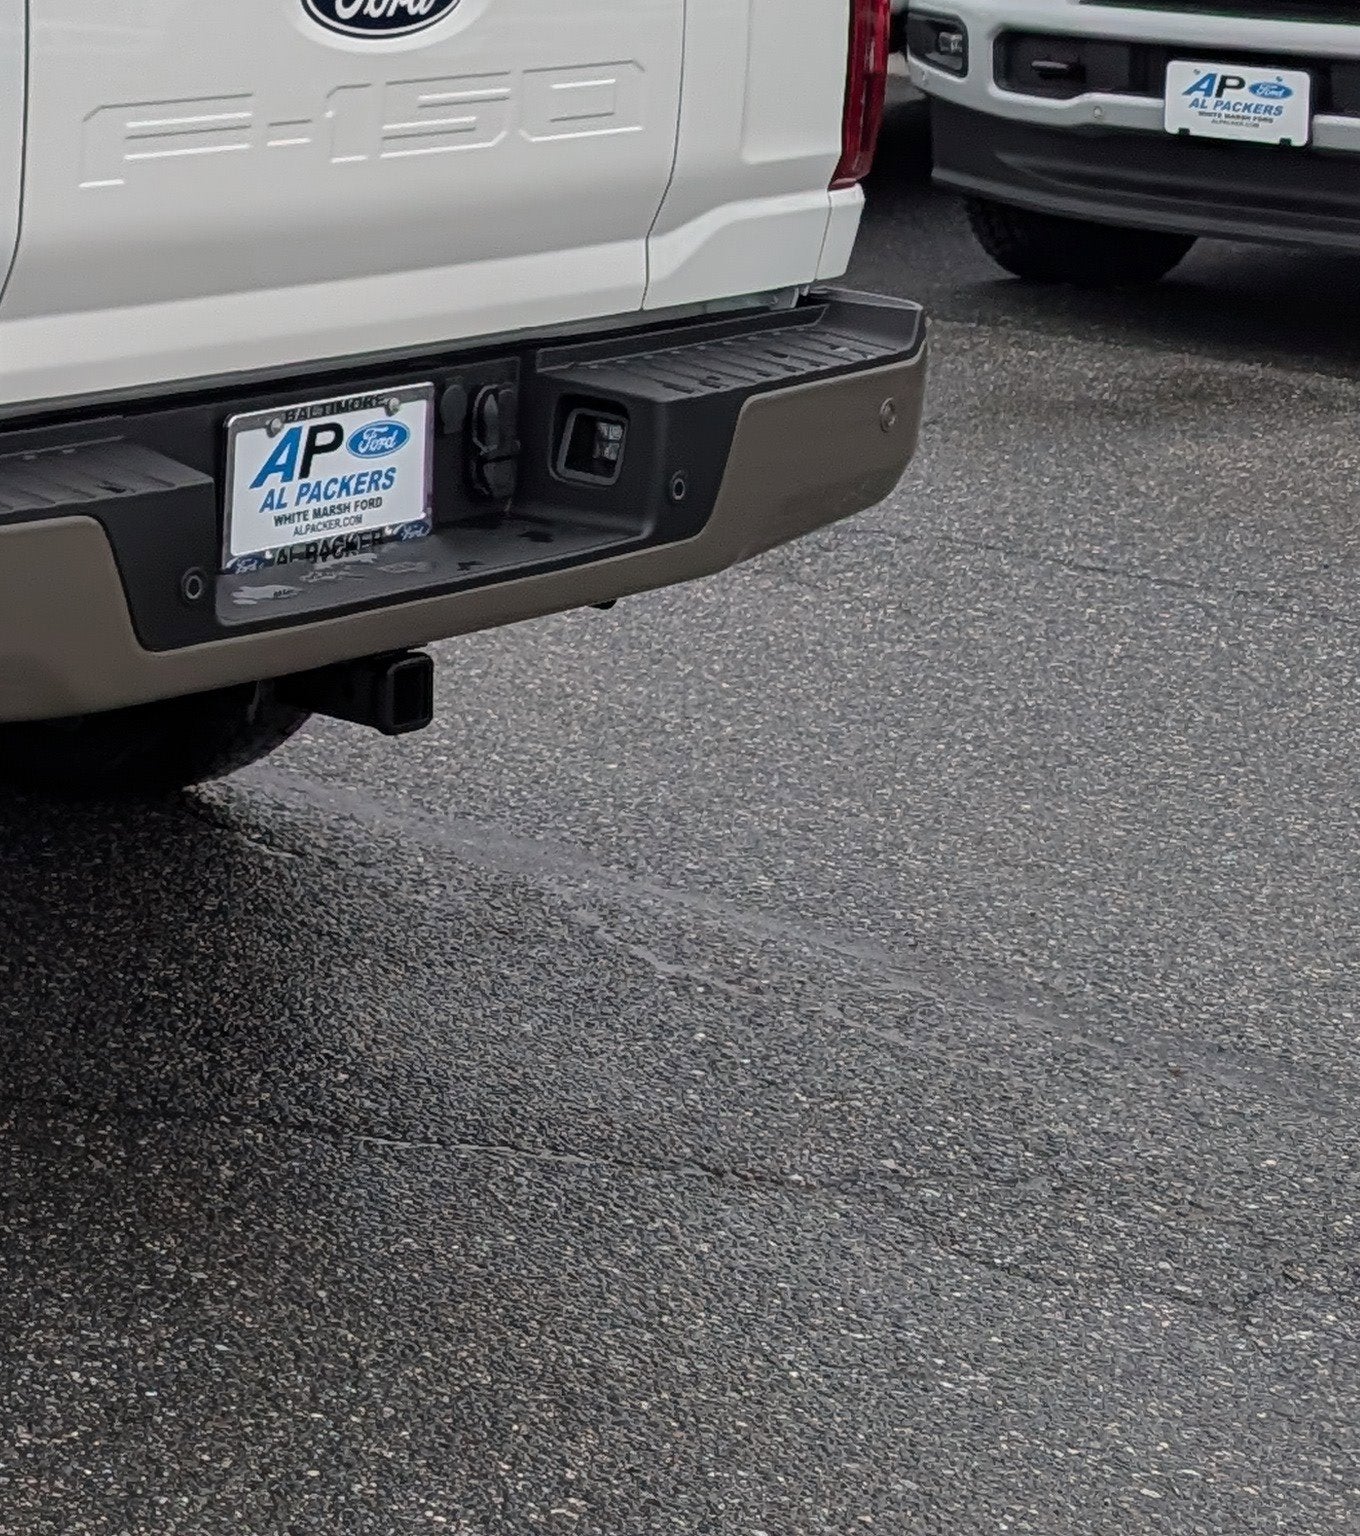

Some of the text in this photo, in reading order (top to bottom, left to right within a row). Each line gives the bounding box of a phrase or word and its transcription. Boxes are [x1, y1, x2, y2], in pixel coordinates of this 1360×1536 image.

[1182, 72, 1246, 99] AP
[1189, 97, 1284, 117] AL PACKERS
[79, 60, 645, 189] F-150
[357, 426, 399, 453] Ford
[249, 421, 345, 491] AP
[259, 466, 398, 514] AL PACKERS
[273, 496, 383, 528] WHITE MARSH FORD
[293, 515, 364, 537] ALPACKER.COM
